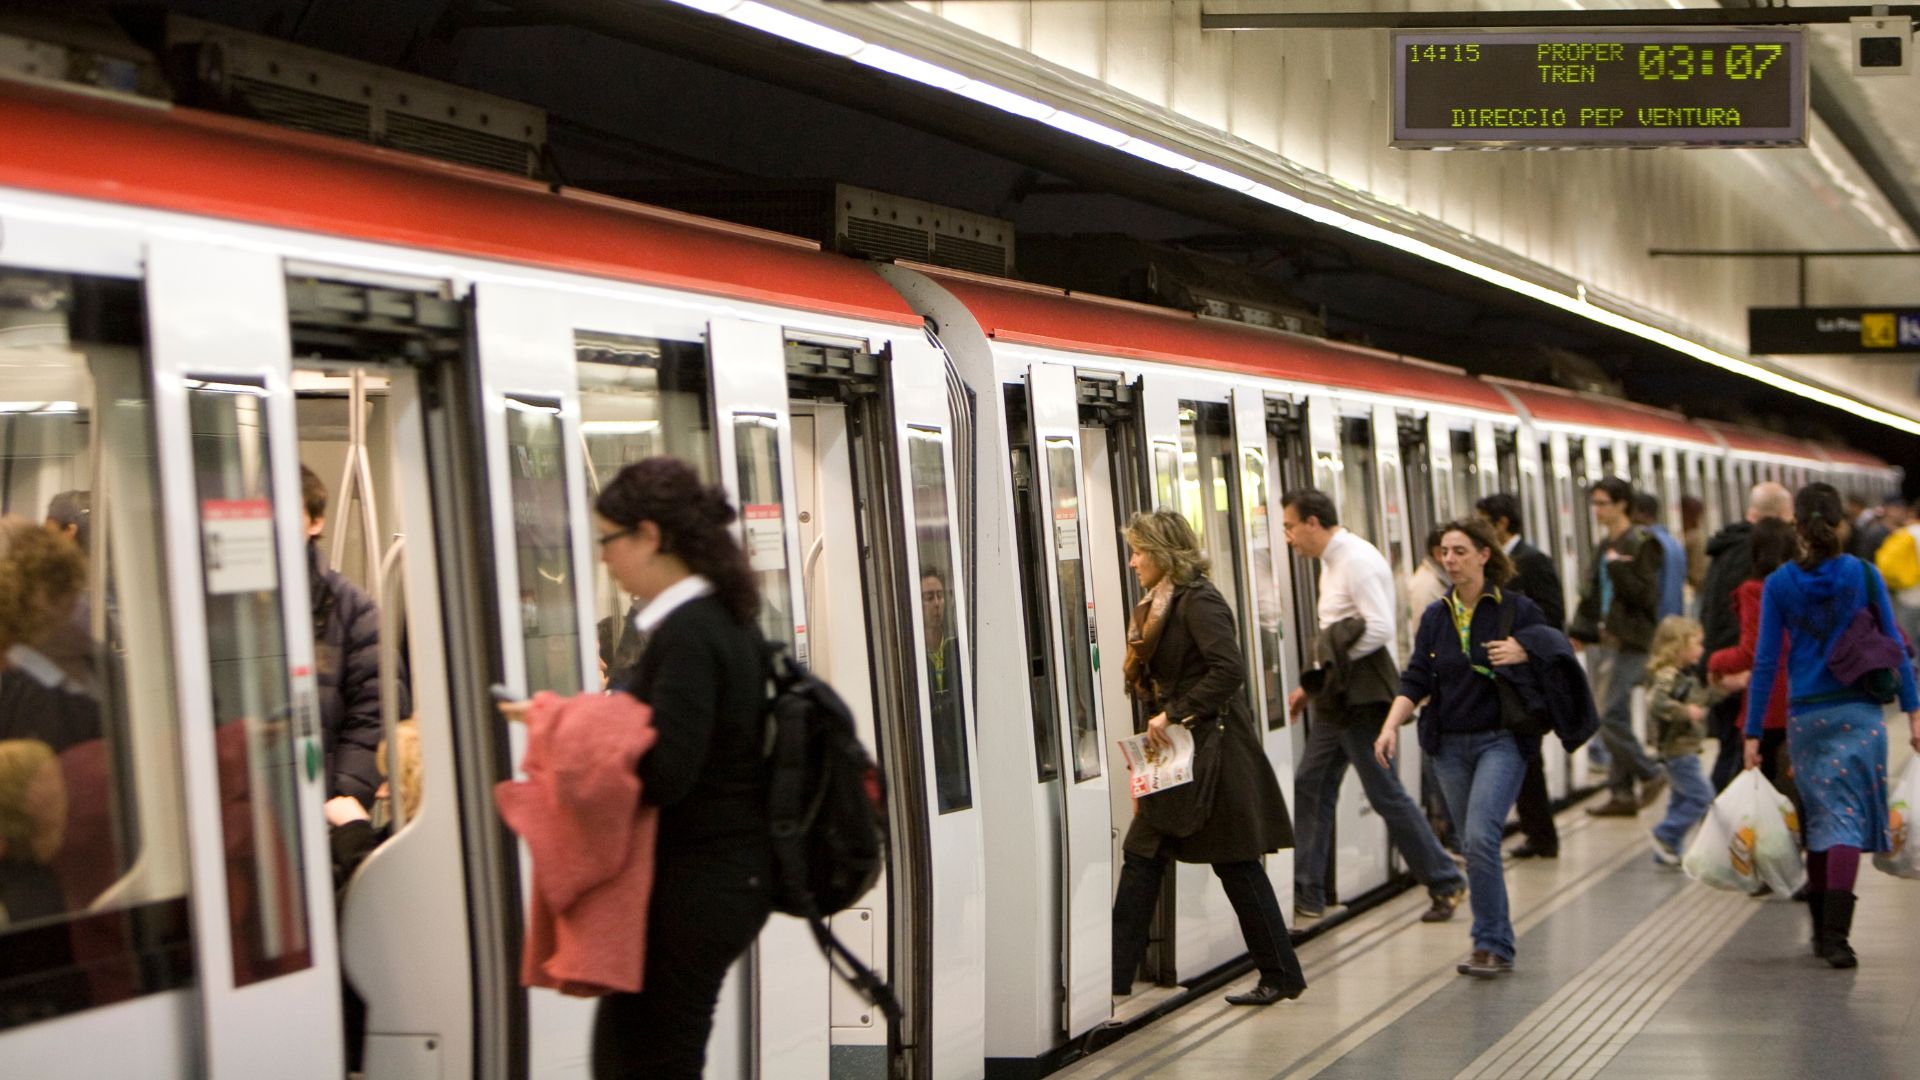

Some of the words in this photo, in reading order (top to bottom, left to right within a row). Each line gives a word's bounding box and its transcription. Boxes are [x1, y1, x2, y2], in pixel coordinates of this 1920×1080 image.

[1409, 43, 1481, 63] 14:15
[1536, 42, 1625, 62] PROPER
[1637, 43, 1783, 81] 03:07
[1537, 63, 1596, 84] TREN
[1579, 107, 1625, 128] PEP
[1637, 107, 1741, 128] VENTURA
